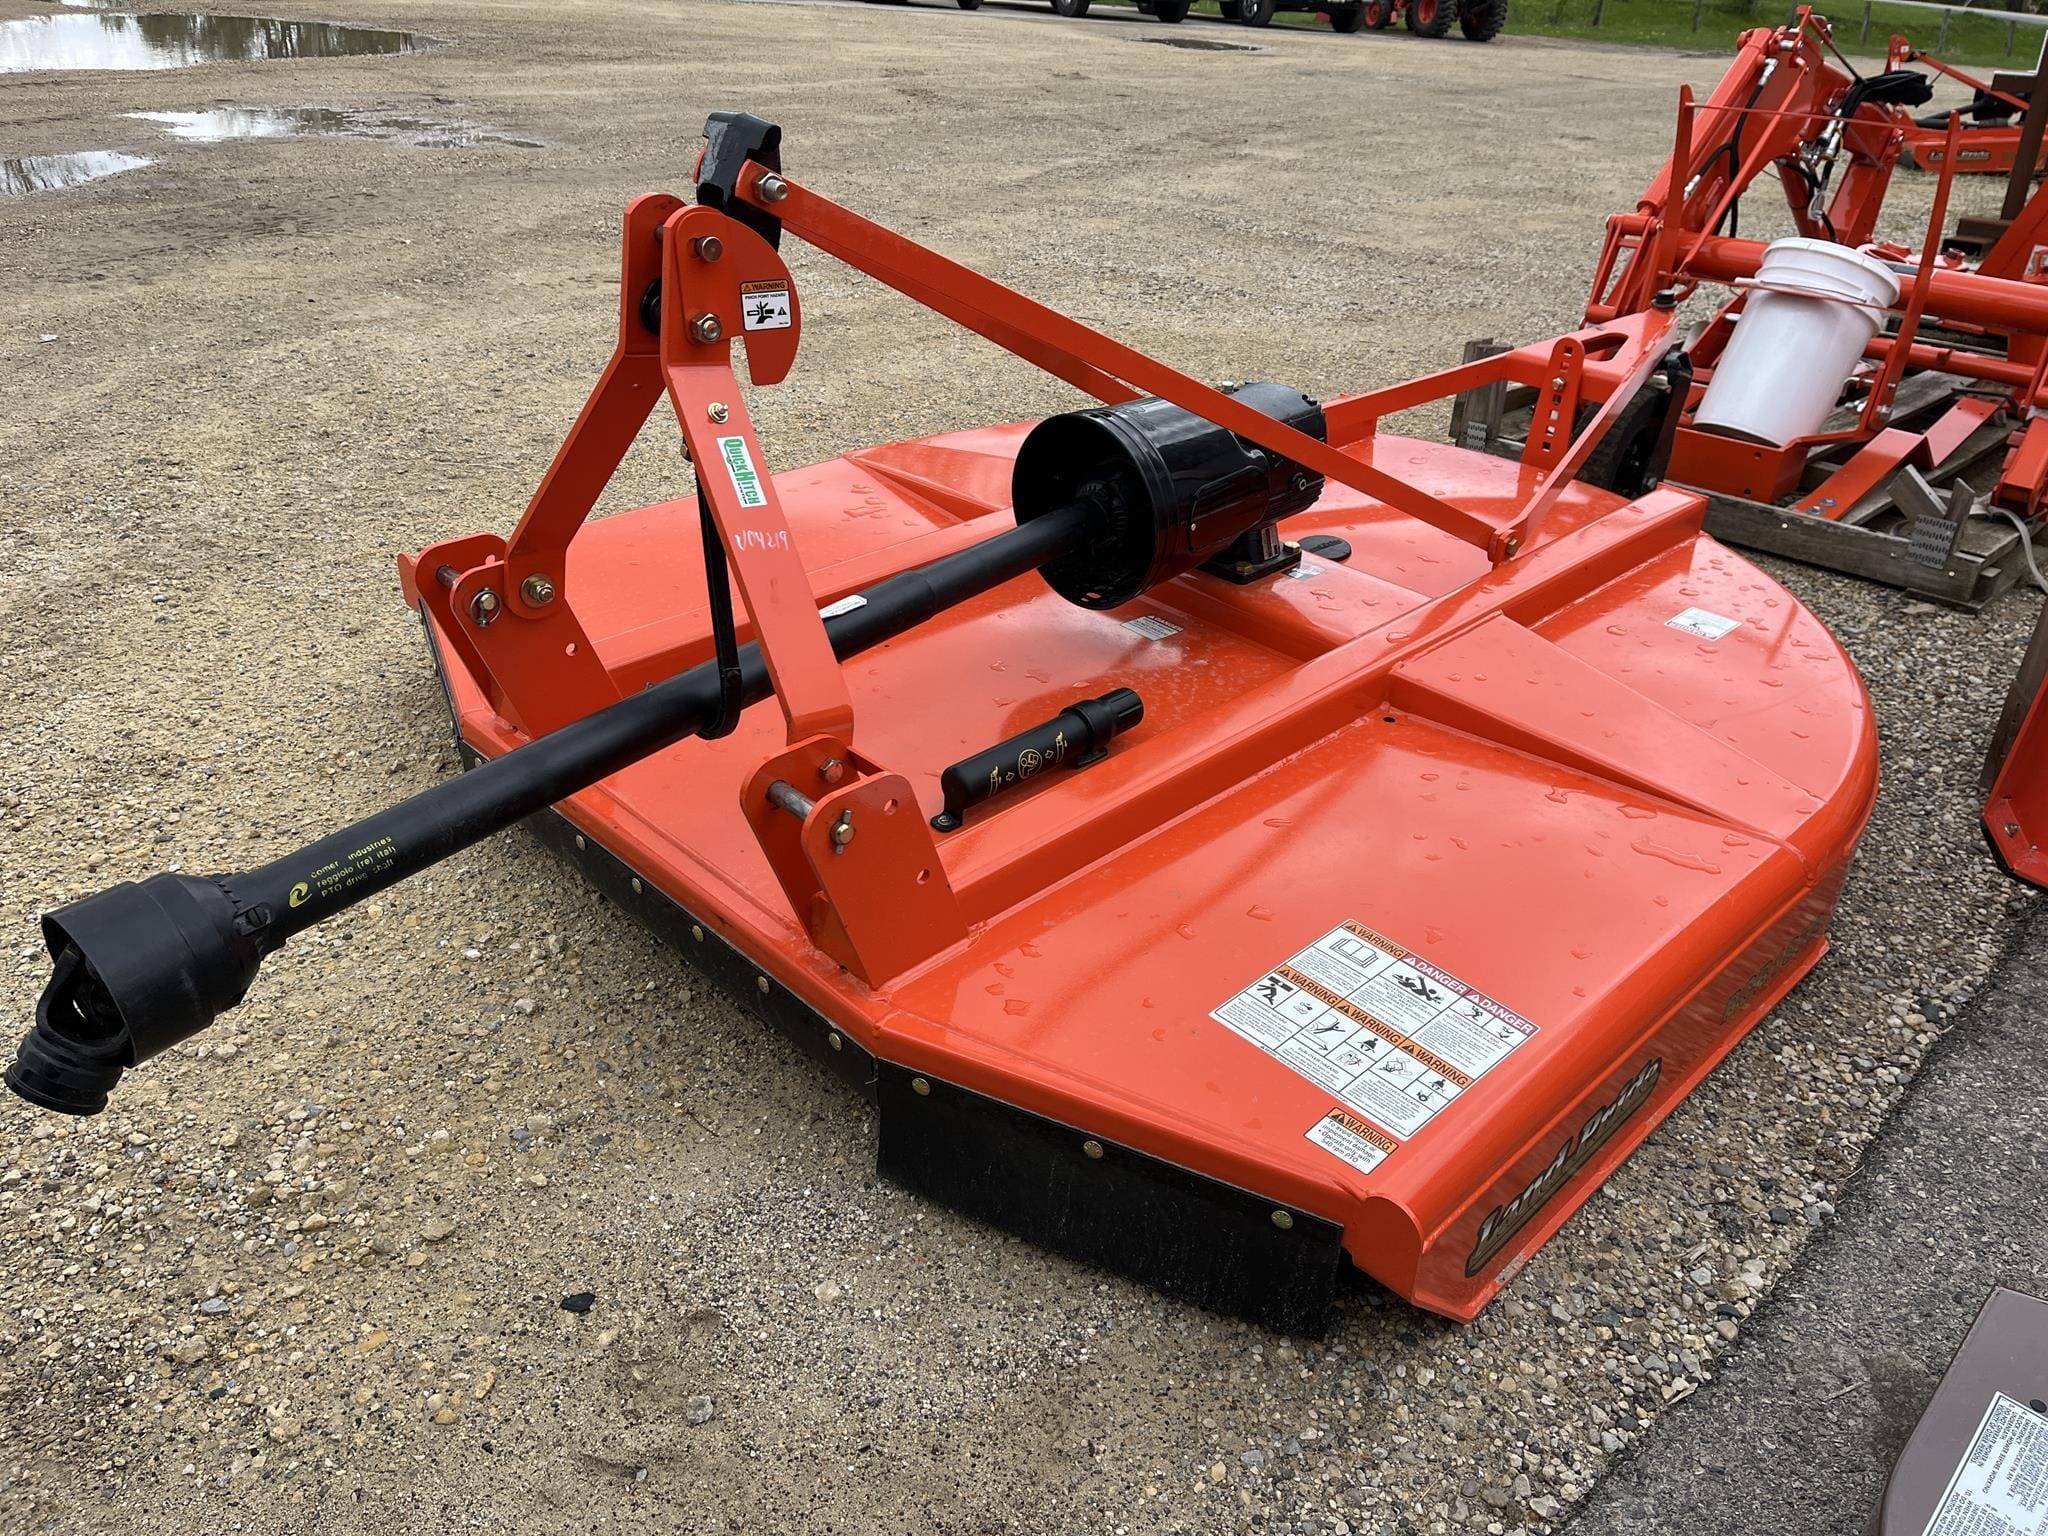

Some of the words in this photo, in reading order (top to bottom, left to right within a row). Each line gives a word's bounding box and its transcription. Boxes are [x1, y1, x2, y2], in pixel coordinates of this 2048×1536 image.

[751, 281, 786, 291] WARNING
[311, 861, 339, 878] comer
[348, 837, 392, 860] industries
[317, 866, 354, 887] reggiolo
[321, 883, 342, 897] PTO
[346, 872, 367, 886] drive
[373, 858, 394, 873] shaft
[1357, 929, 1404, 957] WARNING
[1290, 973, 1338, 1005] WARNING
[1415, 962, 1467, 994] DANGER
[1351, 1009, 1401, 1043] WARNING
[1479, 999, 1533, 1034] DANGER
[1416, 1049, 1468, 1085] WARNING
[1335, 1126, 1353, 1138] avoid
[1352, 1135, 1369, 1148] injury
[1345, 1118, 1392, 1150] WARNING
[1321, 1131, 1345, 1147] Operate
[1344, 1145, 1357, 1156] only
[1357, 1153, 1371, 1163] with
[1332, 1145, 1345, 1155] rpm
[1999, 1415, 2008, 1426] NOT
[2004, 1407, 2012, 1416] DO
[2014, 1415, 2025, 1430] BLOCK
[1989, 1424, 2003, 1444] OPERATE
[2011, 1429, 2018, 1437] UP
[1981, 1444, 1993, 1462] MOWER
[2002, 1436, 2014, 1454] MOWER
[1993, 1453, 2006, 1471] BEFORE
[1982, 1470, 1997, 1494] WORKING
